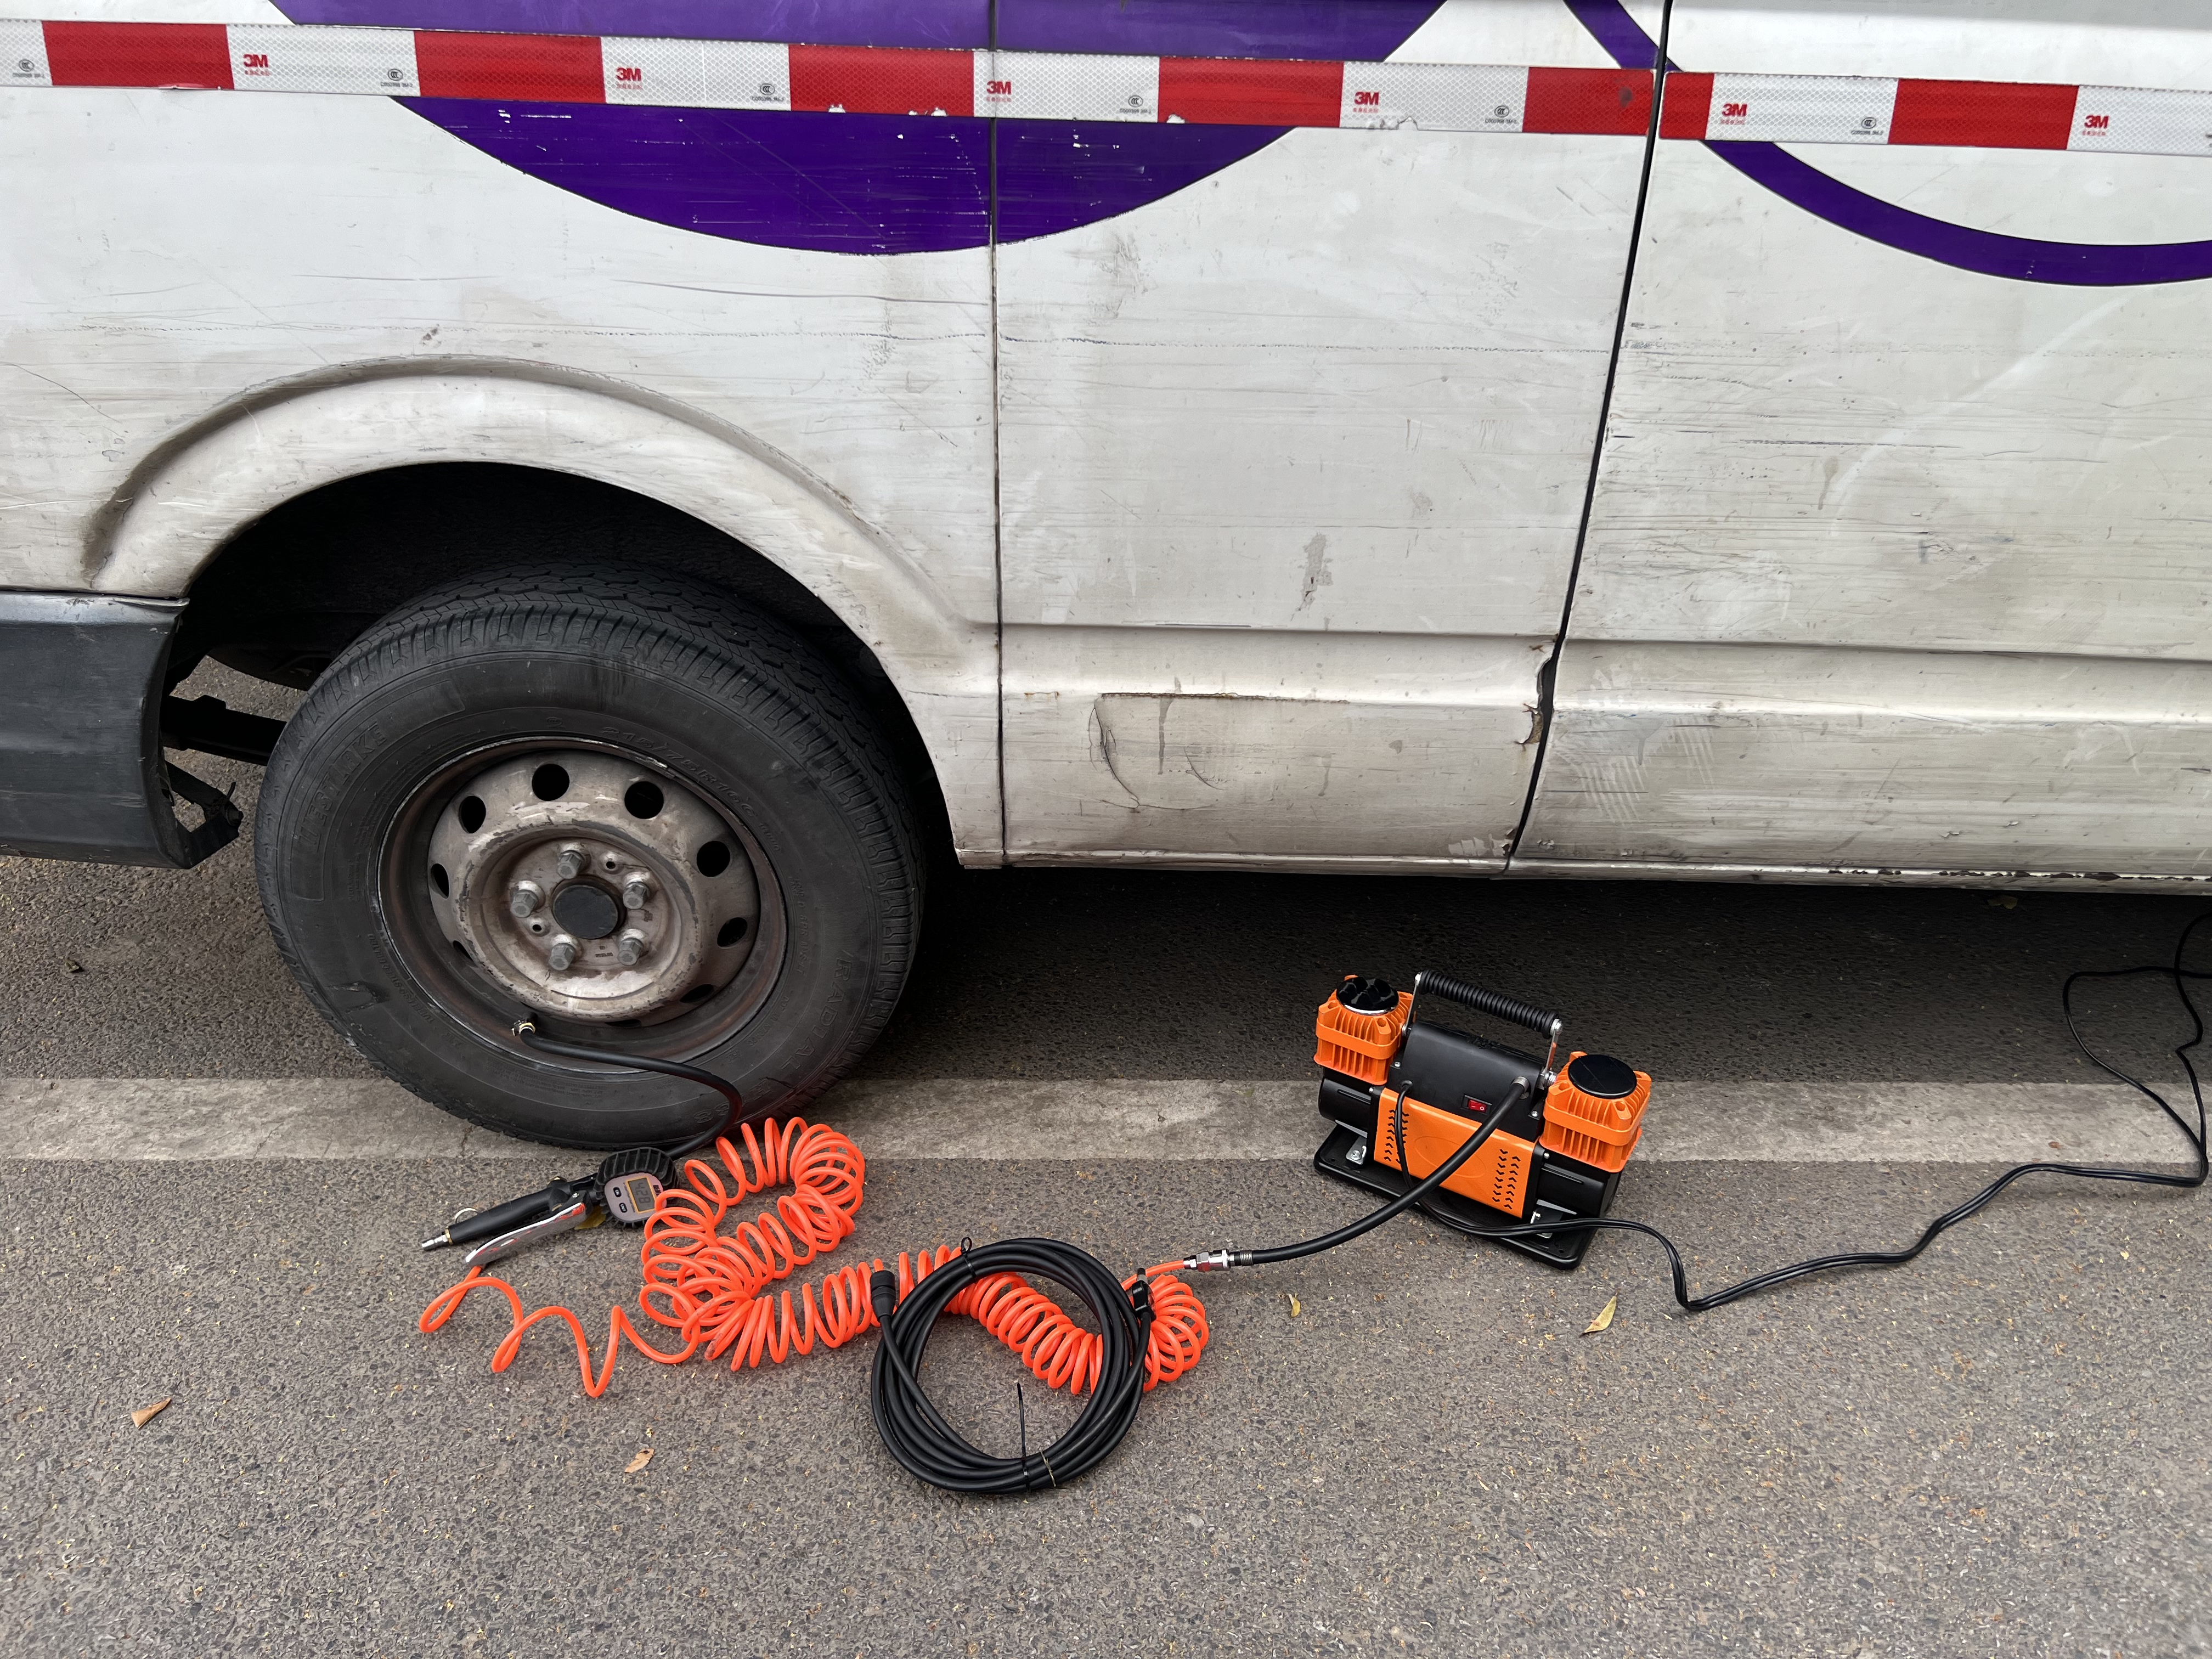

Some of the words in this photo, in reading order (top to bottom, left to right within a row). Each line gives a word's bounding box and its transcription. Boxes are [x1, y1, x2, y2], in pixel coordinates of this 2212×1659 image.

[243, 54, 268, 67] 3M
[616, 67, 641, 81] 3M
[986, 81, 1012, 94] 3M
[1354, 92, 1379, 105] 3M
[1722, 104, 1747, 116] 3M
[2084, 115, 2109, 128] 3M
[295, 722, 391, 851] WESTLAKE
[781, 958, 852, 1070] RADIAL
